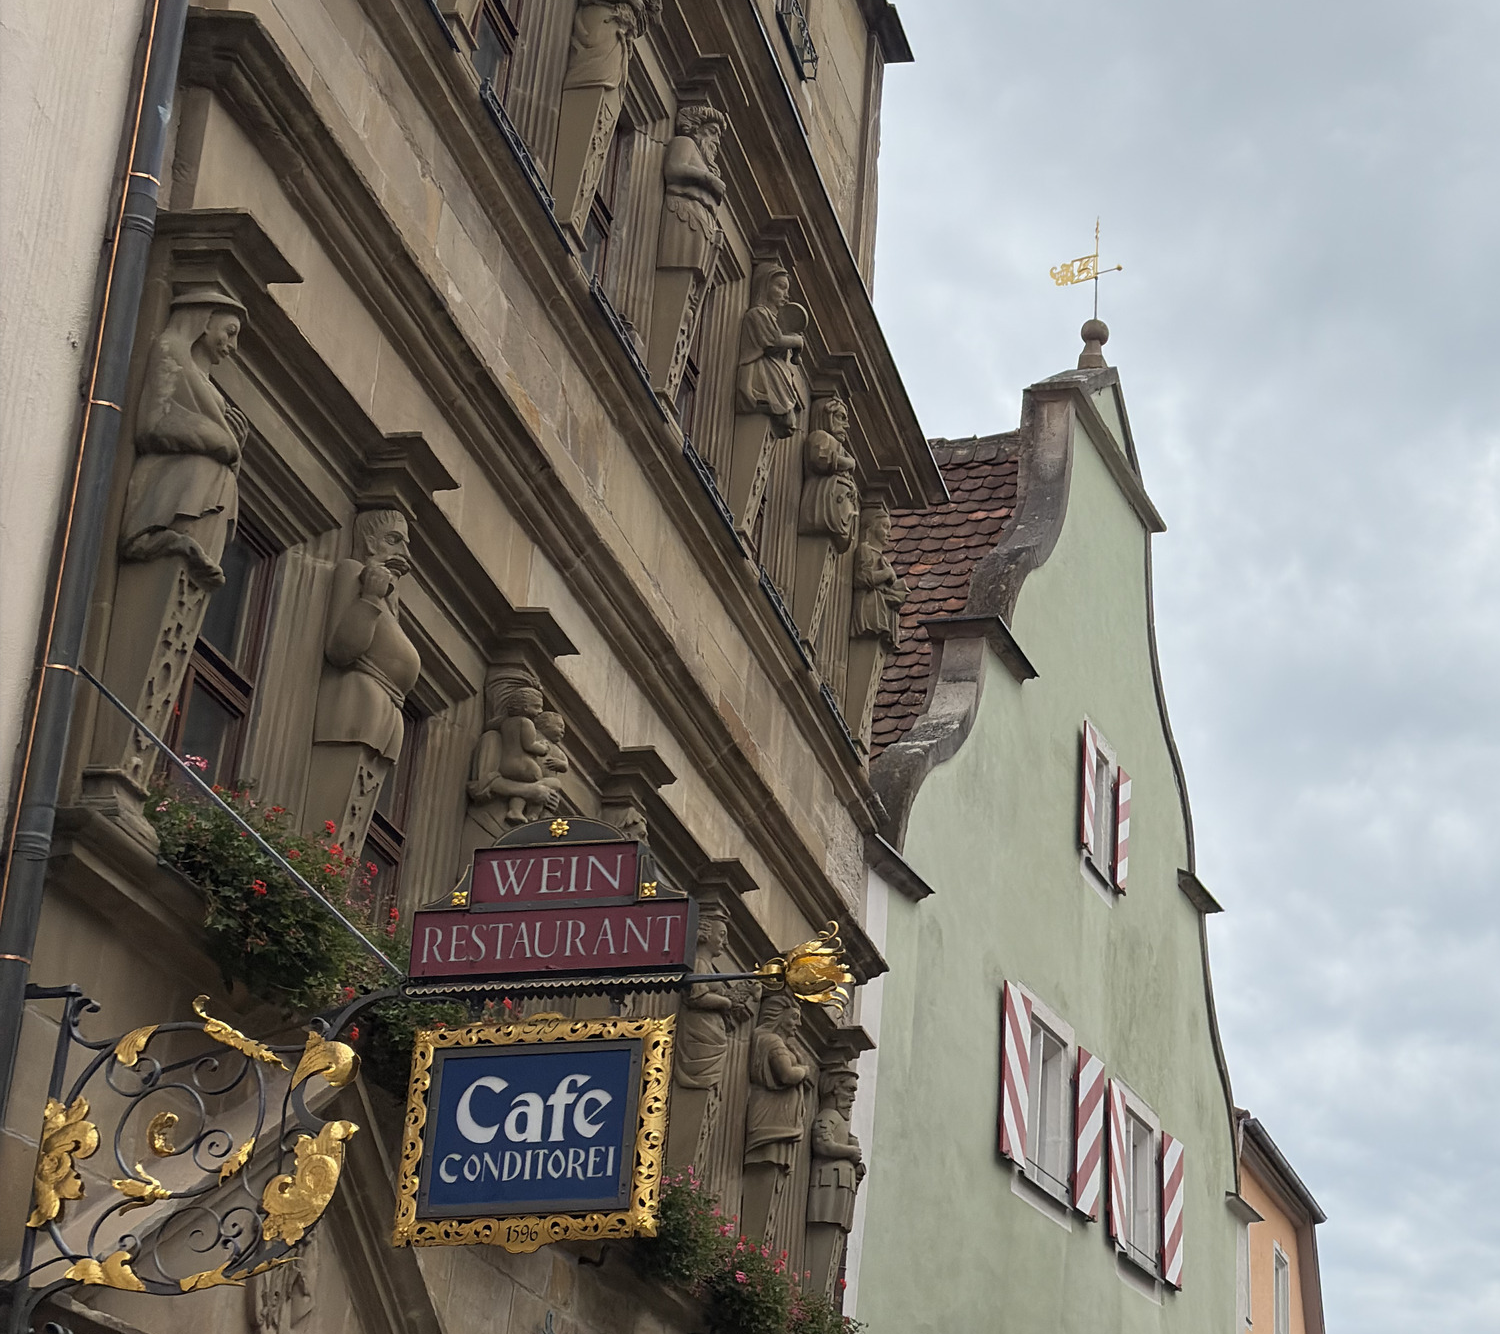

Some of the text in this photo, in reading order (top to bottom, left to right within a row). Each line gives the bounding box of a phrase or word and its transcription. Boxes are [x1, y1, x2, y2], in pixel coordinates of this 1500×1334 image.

[489, 853, 623, 896] WEIN
[420, 914, 682, 964] RESTAURANT
[455, 1073, 613, 1145] Cafe
[438, 1145, 617, 1185] CONDITOREI
[505, 1222, 540, 1244] 1596
